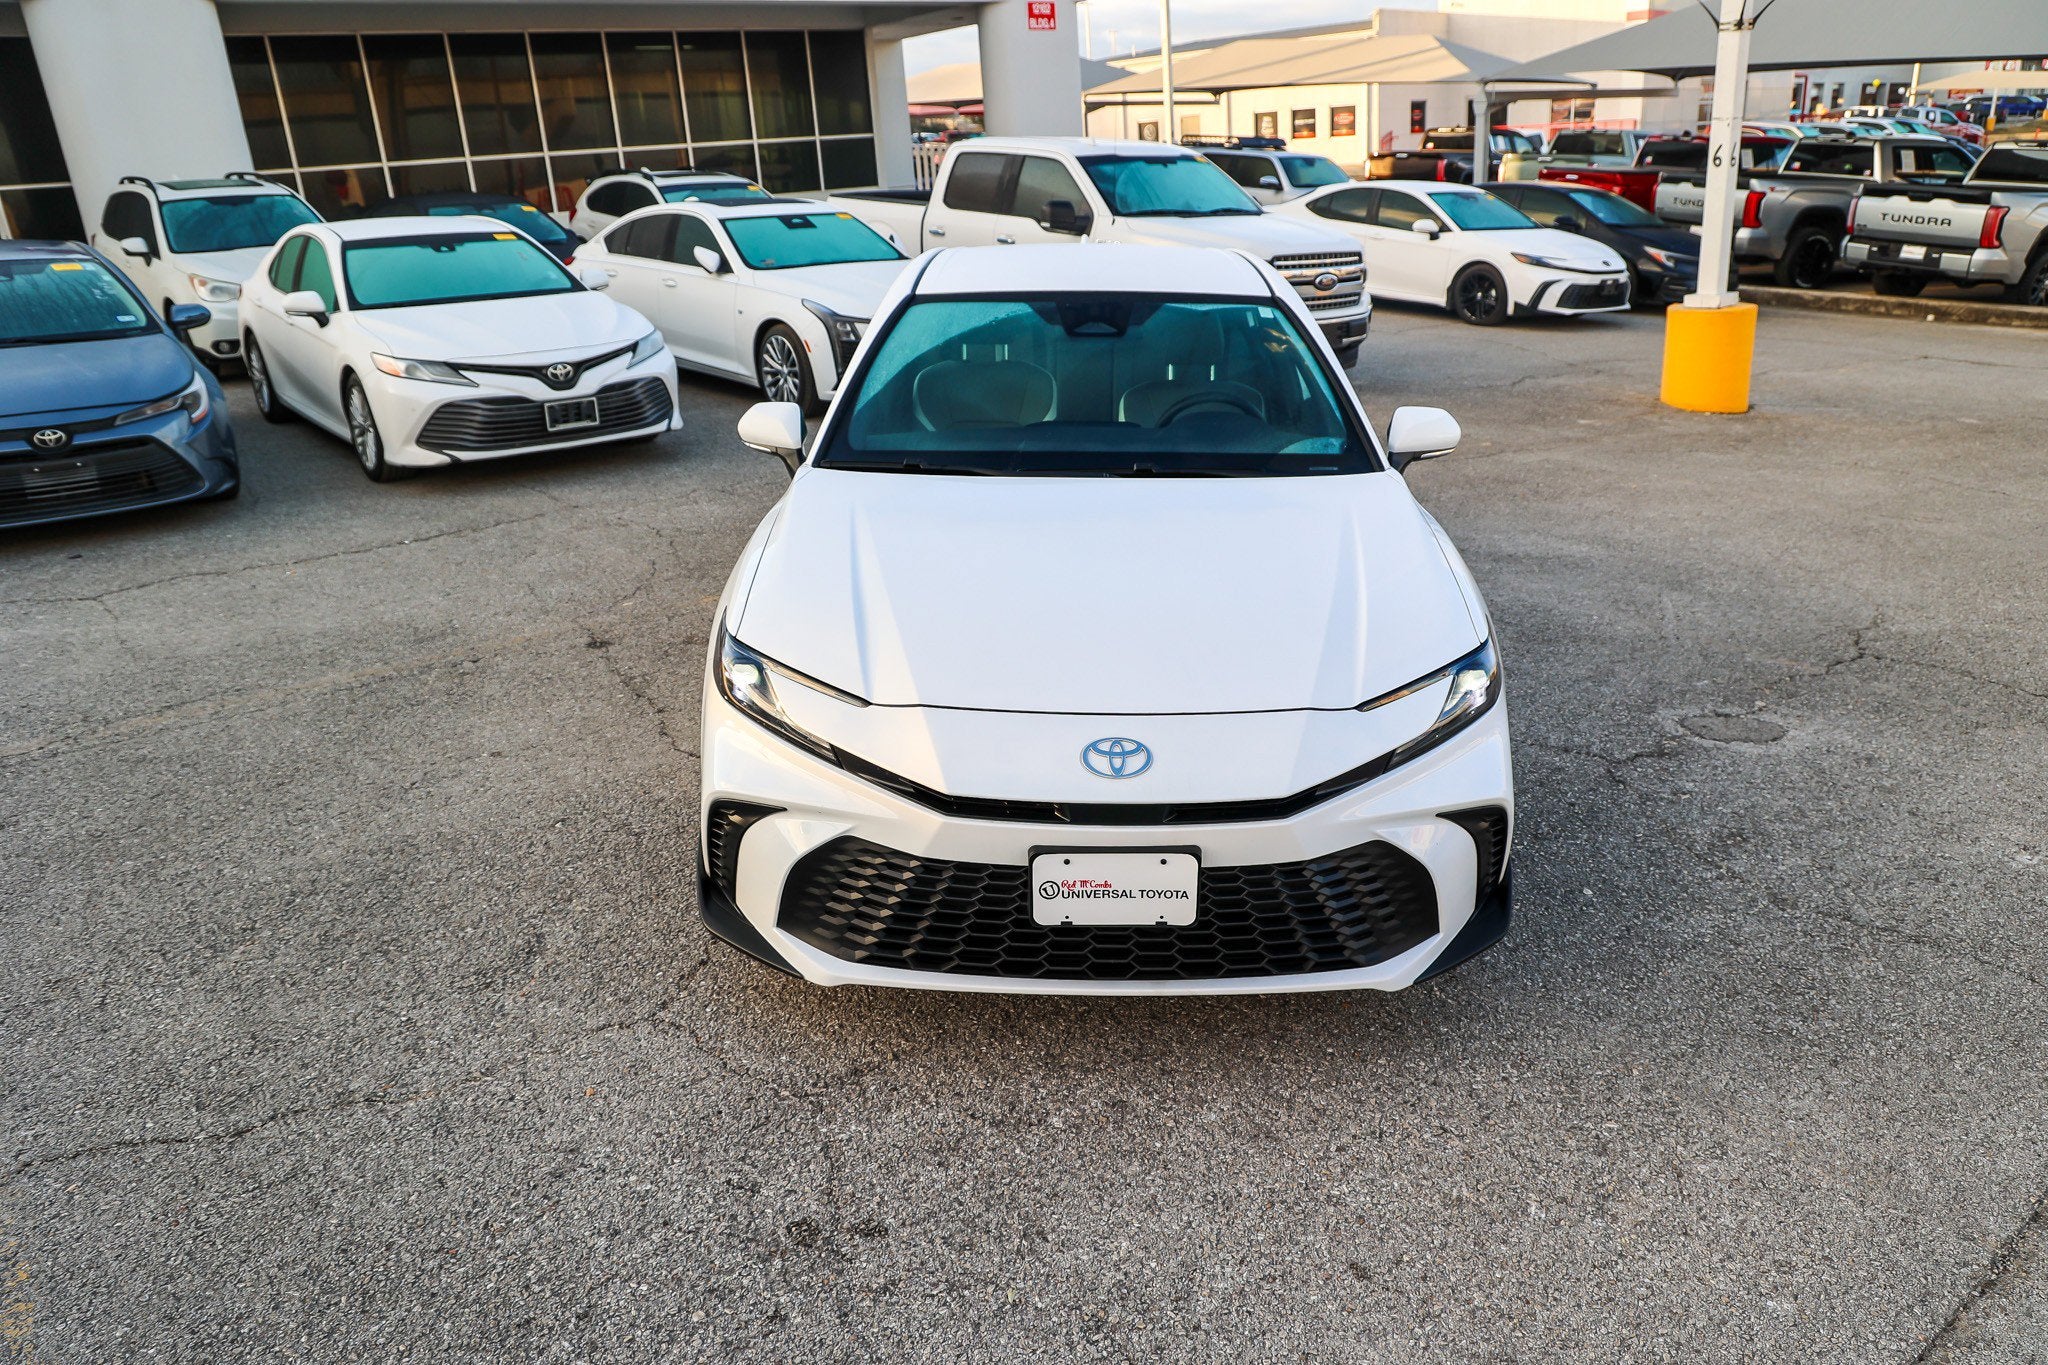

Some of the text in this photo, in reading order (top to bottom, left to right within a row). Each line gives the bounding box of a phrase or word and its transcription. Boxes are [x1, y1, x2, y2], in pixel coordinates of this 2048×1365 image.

[1713, 144, 1722, 167] 6
[1730, 142, 1737, 167] 6
[1673, 196, 1704, 207] TUND
[1881, 212, 1952, 227] TUNDRA
[1061, 880, 1077, 891] Red
[1061, 889, 1190, 900] UNIVERSAL TOYOTA
